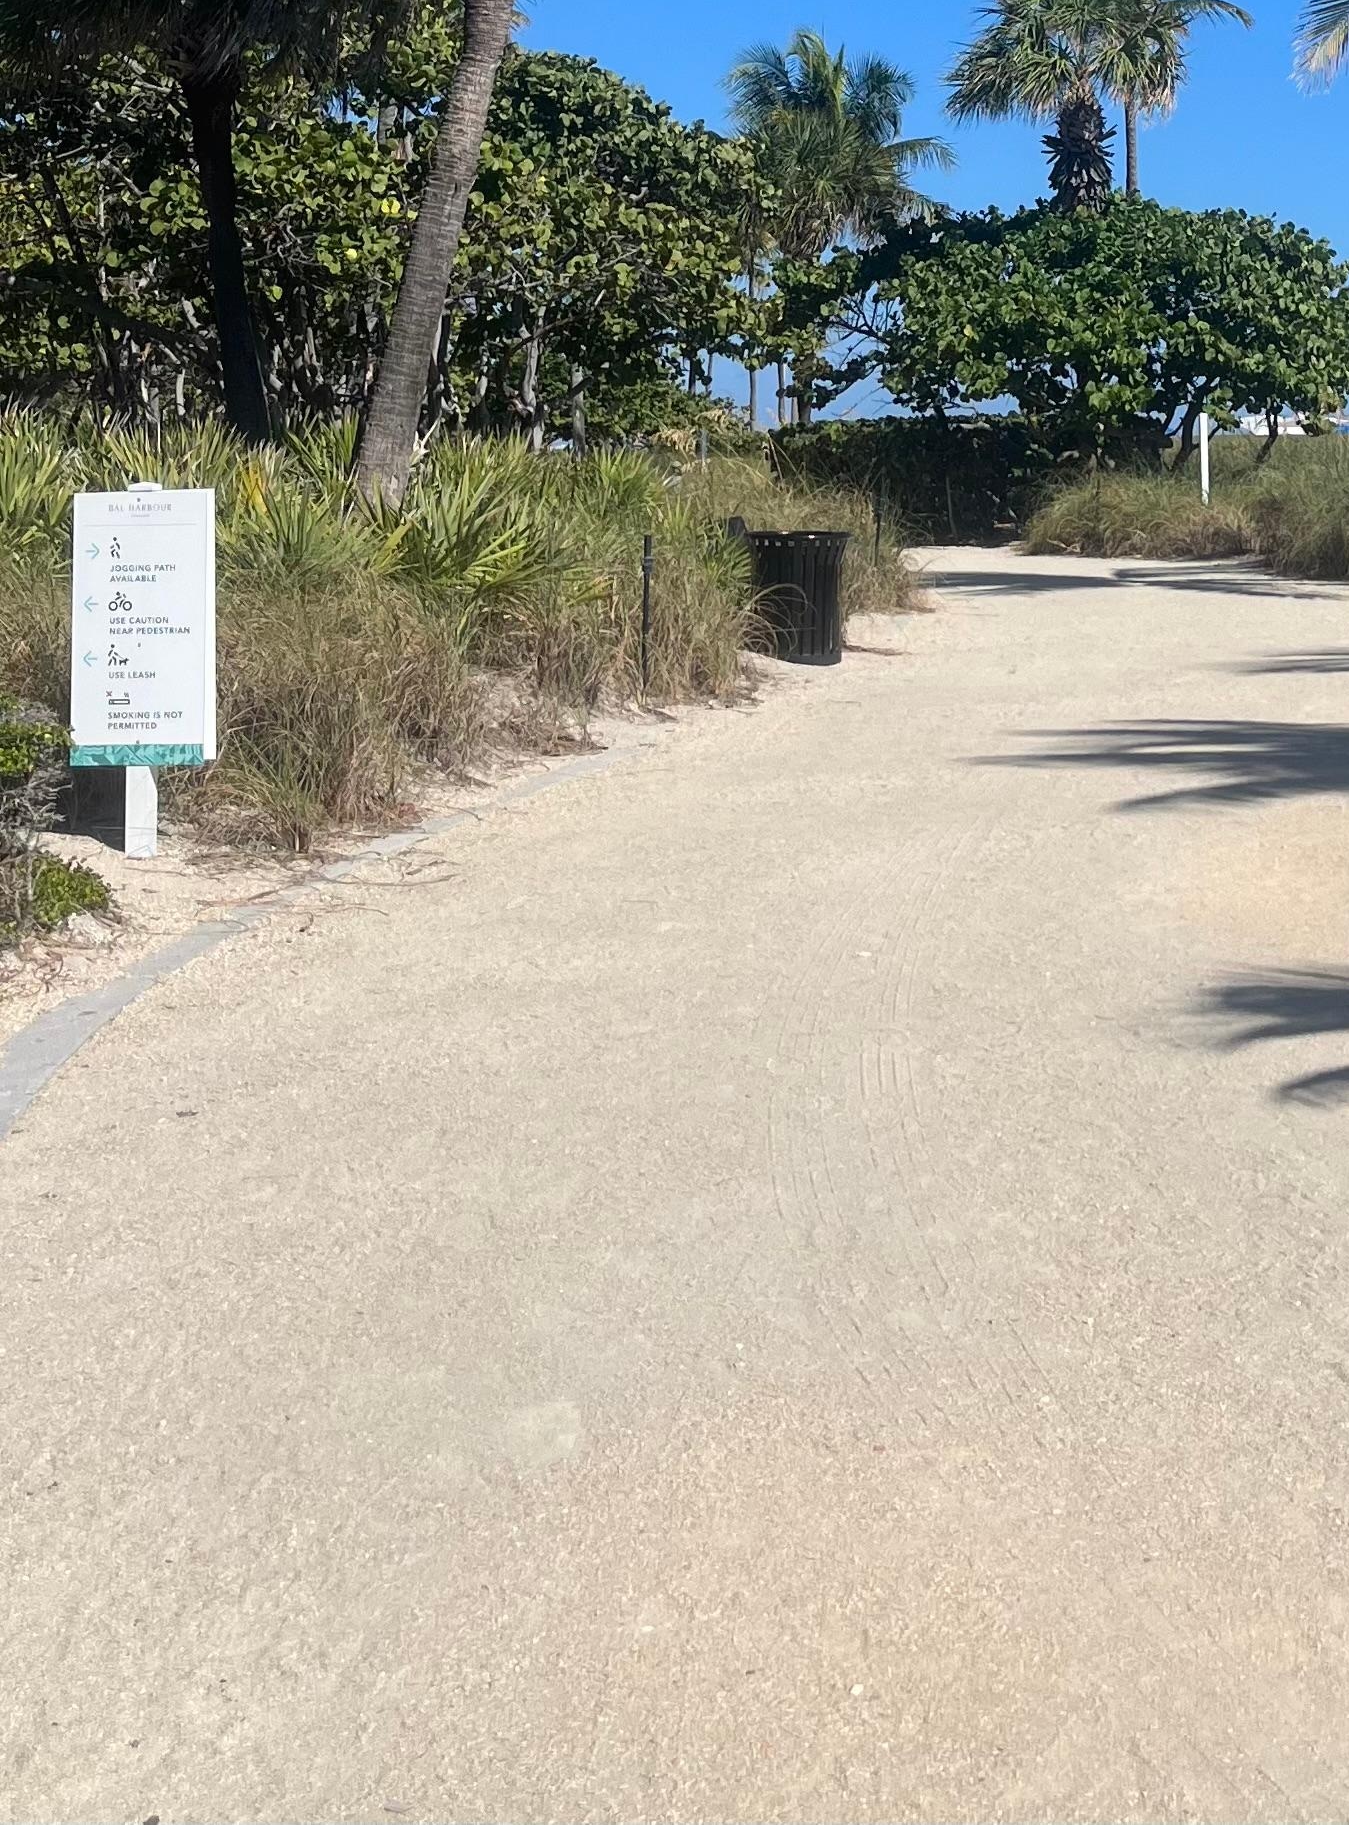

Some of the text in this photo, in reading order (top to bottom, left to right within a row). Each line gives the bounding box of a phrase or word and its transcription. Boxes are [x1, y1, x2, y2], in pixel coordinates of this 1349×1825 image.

[109, 503, 172, 512] BAL HARBOUR
[110, 564, 176, 572] JOGGING PATH
[129, 616, 169, 624] CAUTION
[136, 627, 191, 635] PEDESTRIAN
[128, 671, 156, 679] LEASH
[107, 711, 183, 719] SMOKING IS NOT
[107, 722, 157, 730] PERMITTED
